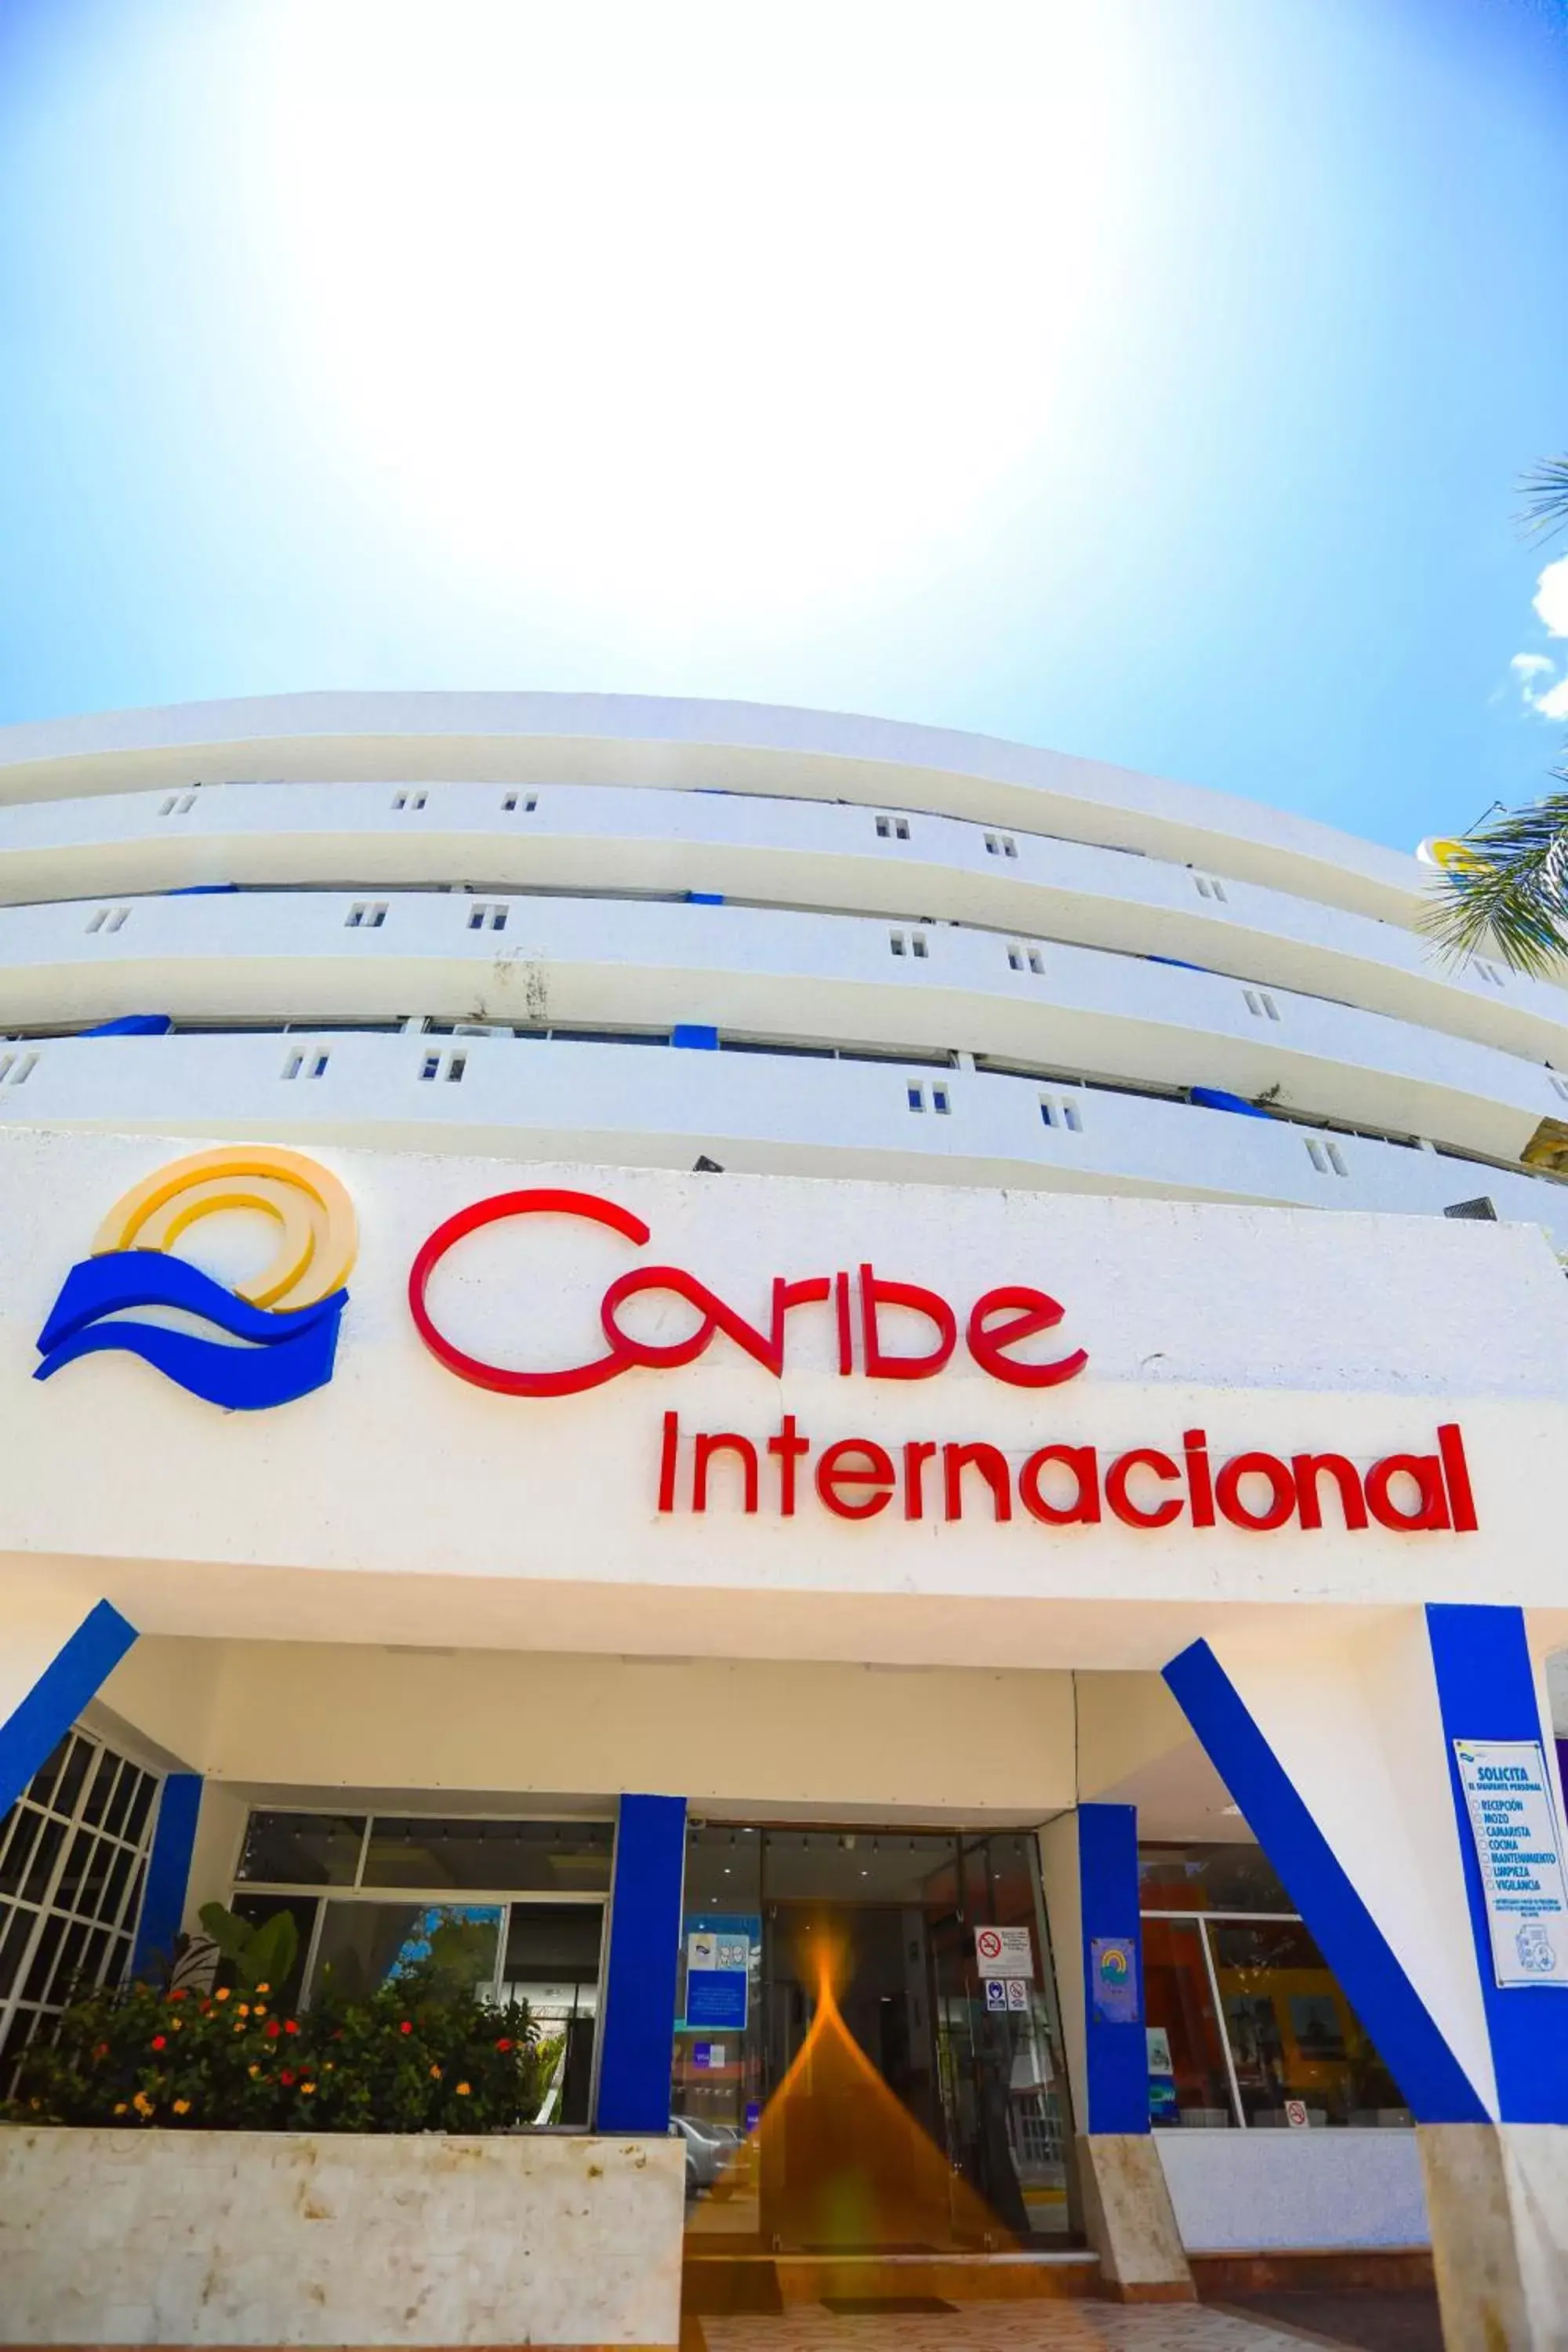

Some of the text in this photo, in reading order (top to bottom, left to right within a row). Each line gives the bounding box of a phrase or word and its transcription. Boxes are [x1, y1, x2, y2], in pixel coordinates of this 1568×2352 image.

[408, 1189, 1088, 1398] Caribe
[658, 1410, 1479, 1534] Internacional
[1478, 1767, 1529, 1781] SOLICITA
[1484, 1813, 1509, 1824] MOZO
[1486, 1826, 1531, 1837] CAMARISTA
[1490, 1839, 1519, 1850] COCINA
[1494, 1867, 1530, 1878] LIMPIEZA
[1495, 1879, 1541, 1891] VIGILANCIA
